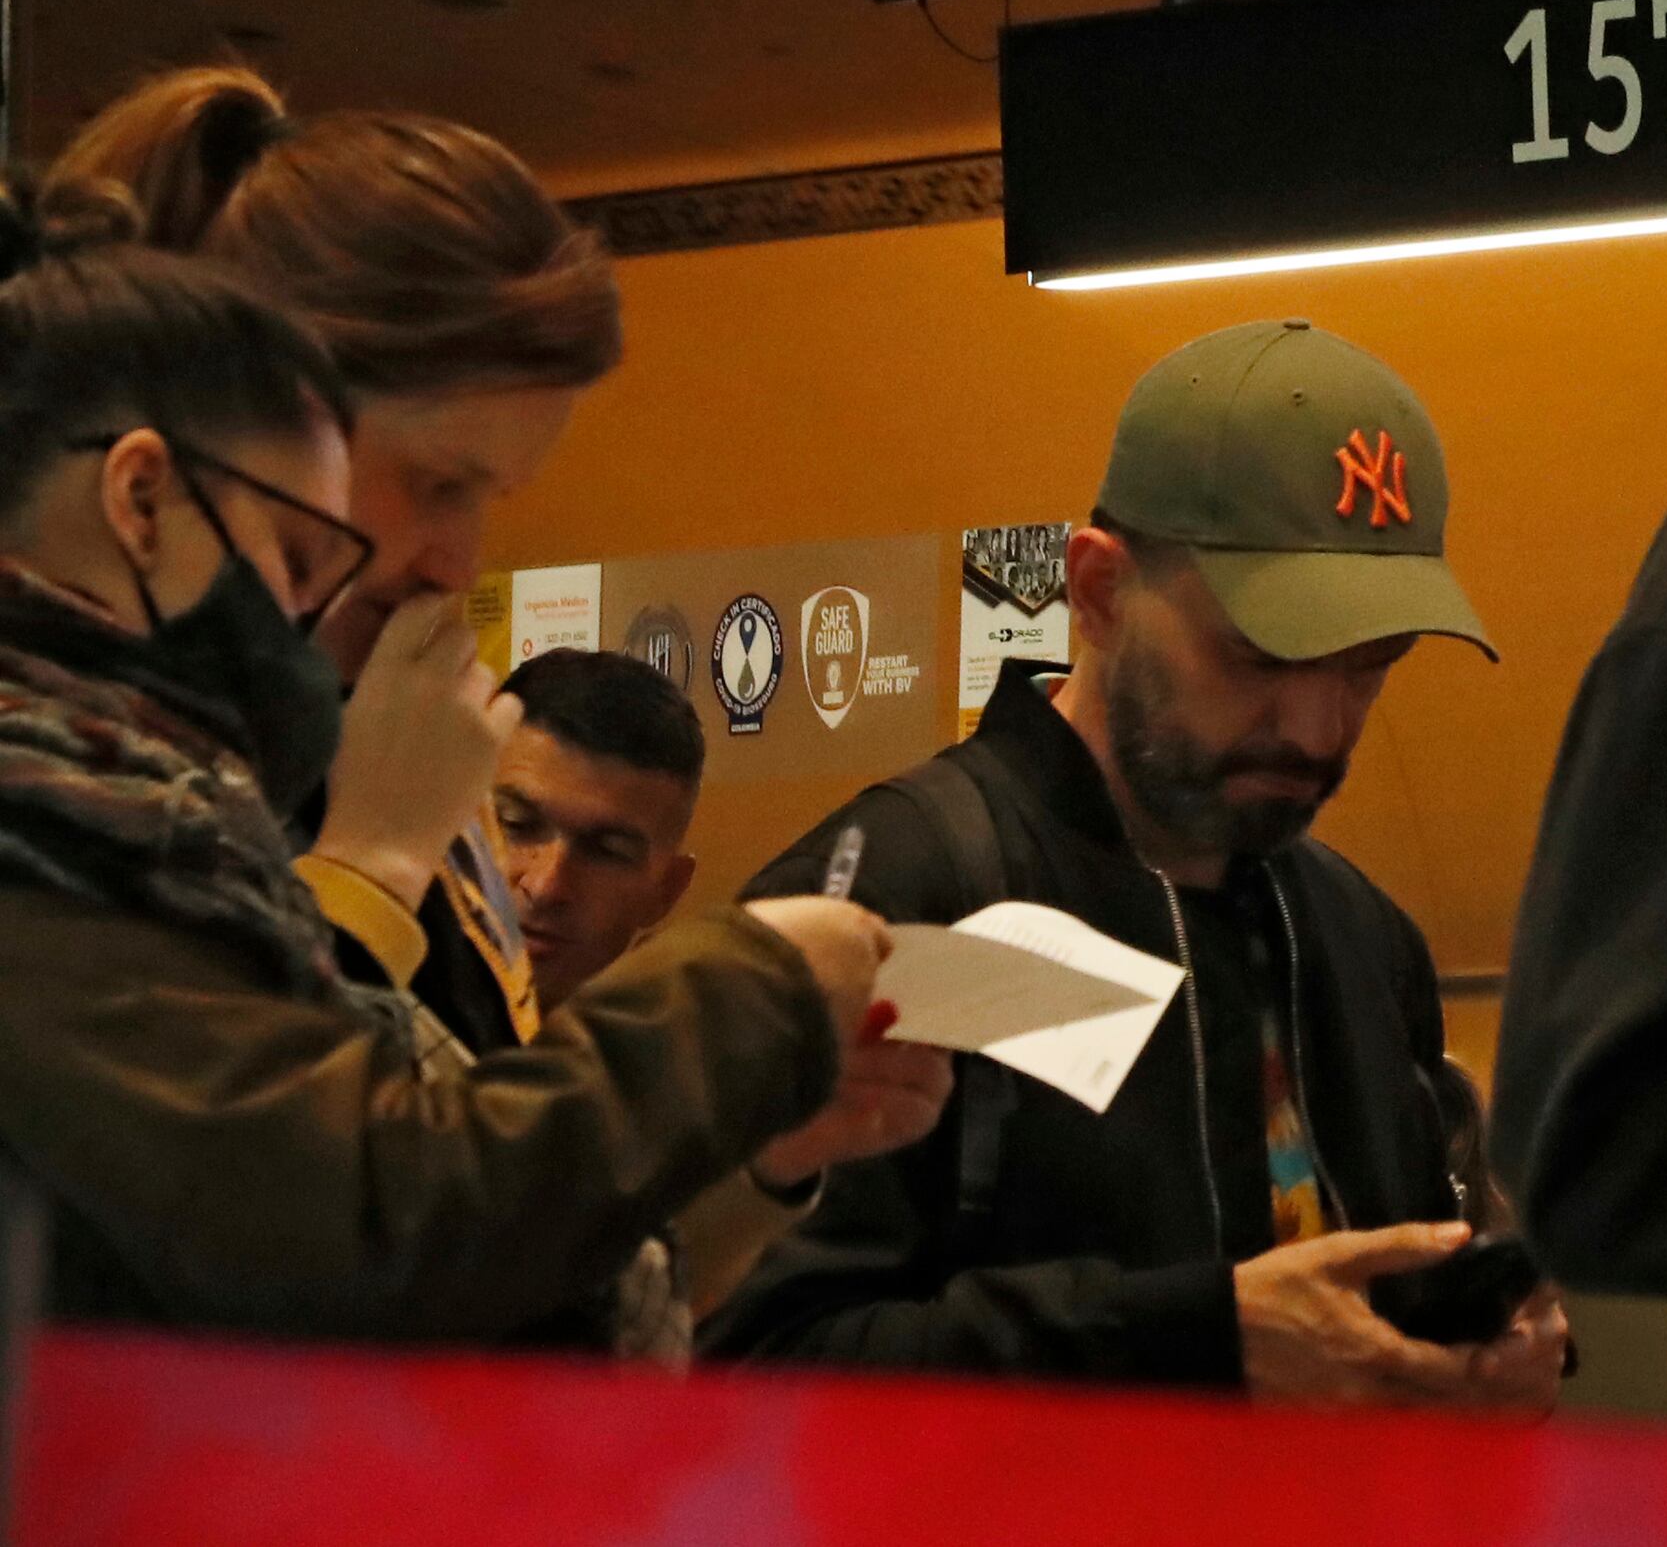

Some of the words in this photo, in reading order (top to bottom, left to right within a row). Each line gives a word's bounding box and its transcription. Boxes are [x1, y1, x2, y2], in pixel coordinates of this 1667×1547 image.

[1336, 428, 1412, 528] NY
[713, 614, 731, 661] CHECK
[730, 603, 740, 617] IN
[740, 597, 782, 655] CERTIFICADO
[821, 605, 850, 631] SAFE
[815, 629, 854, 655] GUARD
[868, 655, 909, 669] RESTART
[863, 678, 892, 695] WITH
